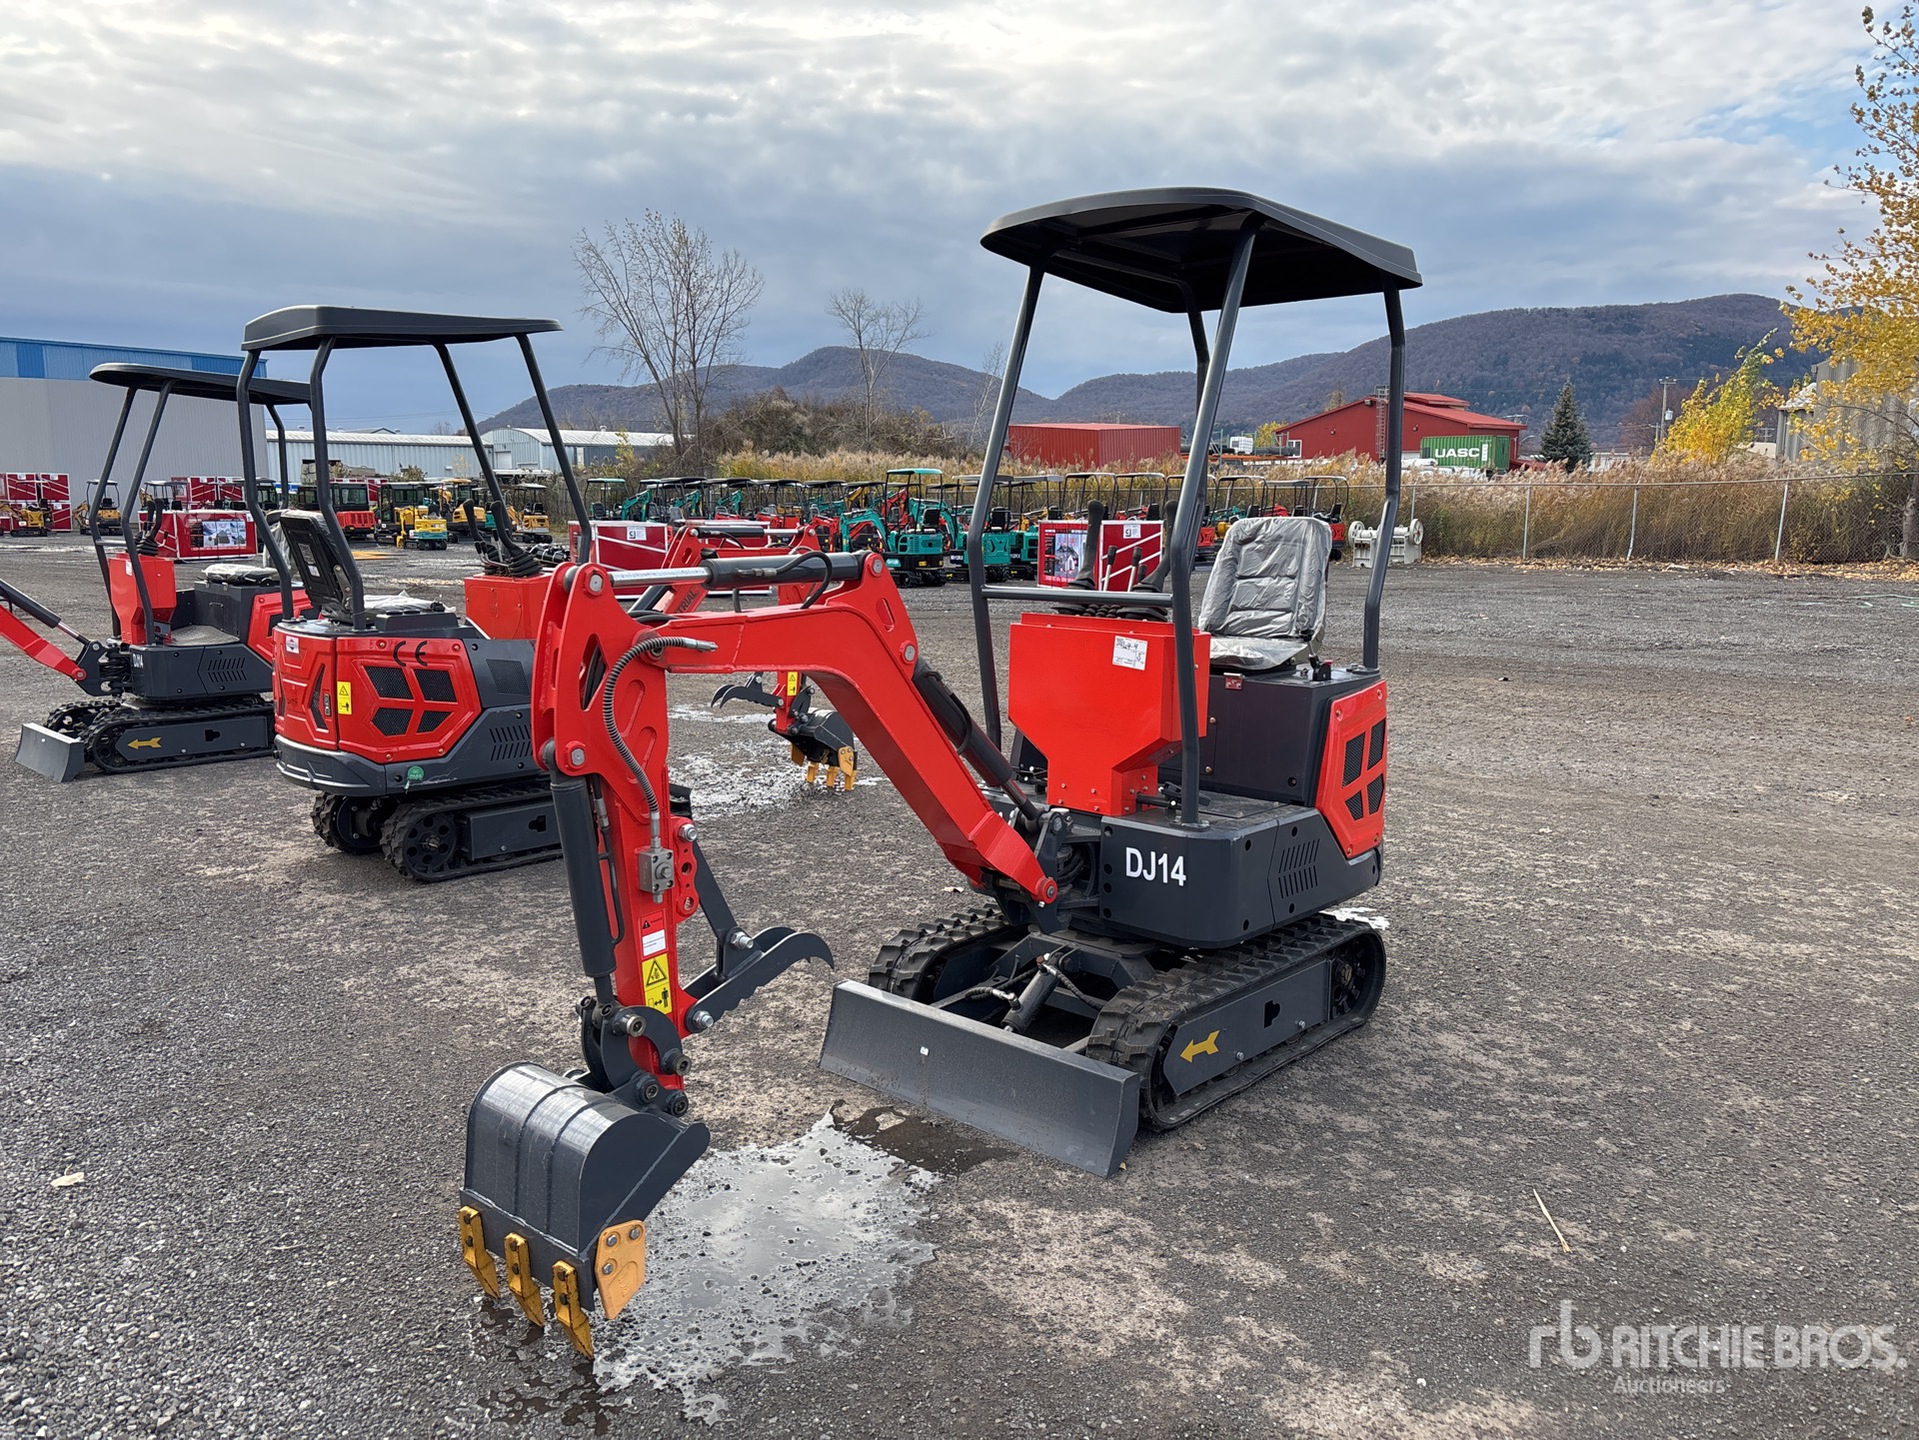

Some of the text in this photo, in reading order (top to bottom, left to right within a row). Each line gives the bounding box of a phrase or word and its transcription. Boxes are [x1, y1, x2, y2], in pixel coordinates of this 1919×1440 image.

[1435, 448, 1480, 458] UASC
[393, 640, 428, 667] CE
[1125, 847, 1187, 886] DJ14
